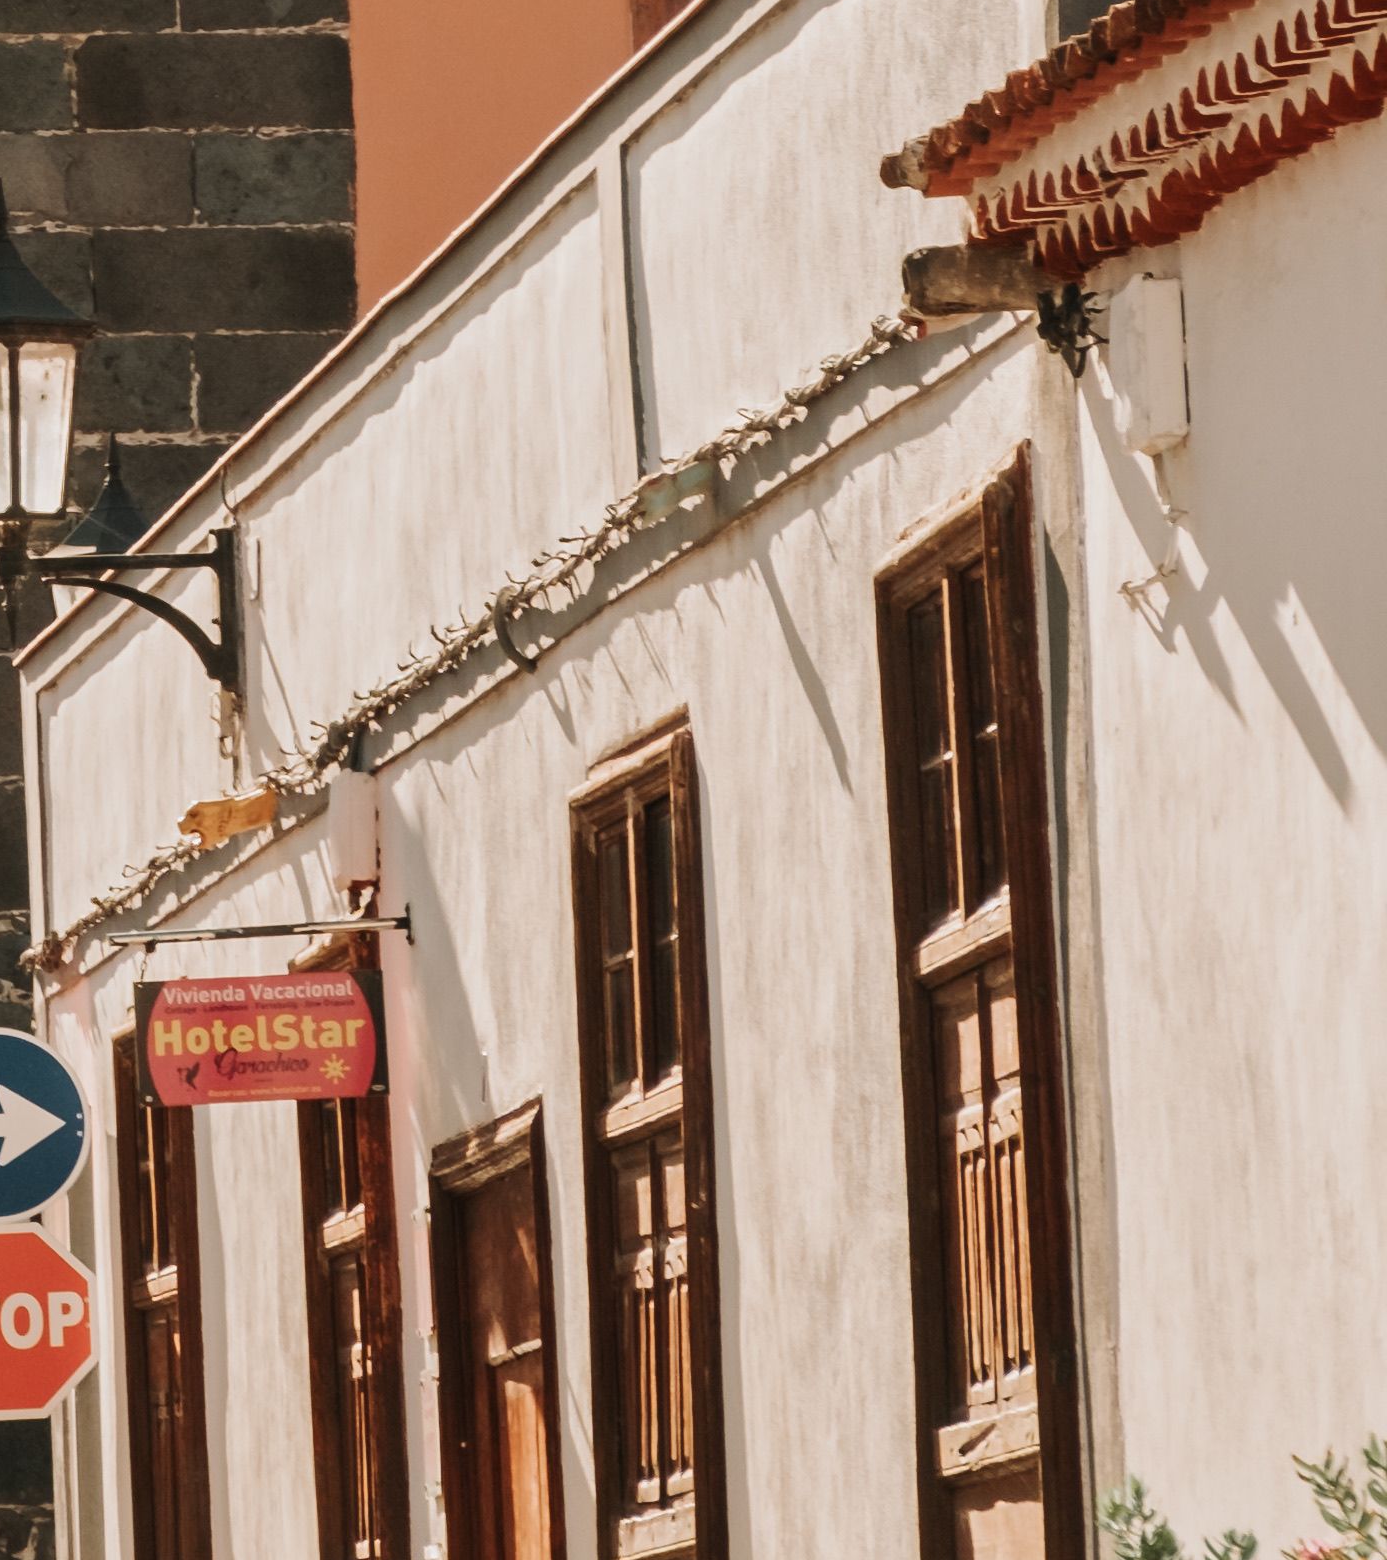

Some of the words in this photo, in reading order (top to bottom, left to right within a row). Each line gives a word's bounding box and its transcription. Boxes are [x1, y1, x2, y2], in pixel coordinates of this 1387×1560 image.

[162, 984, 246, 1004] Vivienda
[249, 979, 354, 1000] Vacacional
[153, 1014, 366, 1056] HotelStar
[214, 1047, 309, 1080] Garachico
